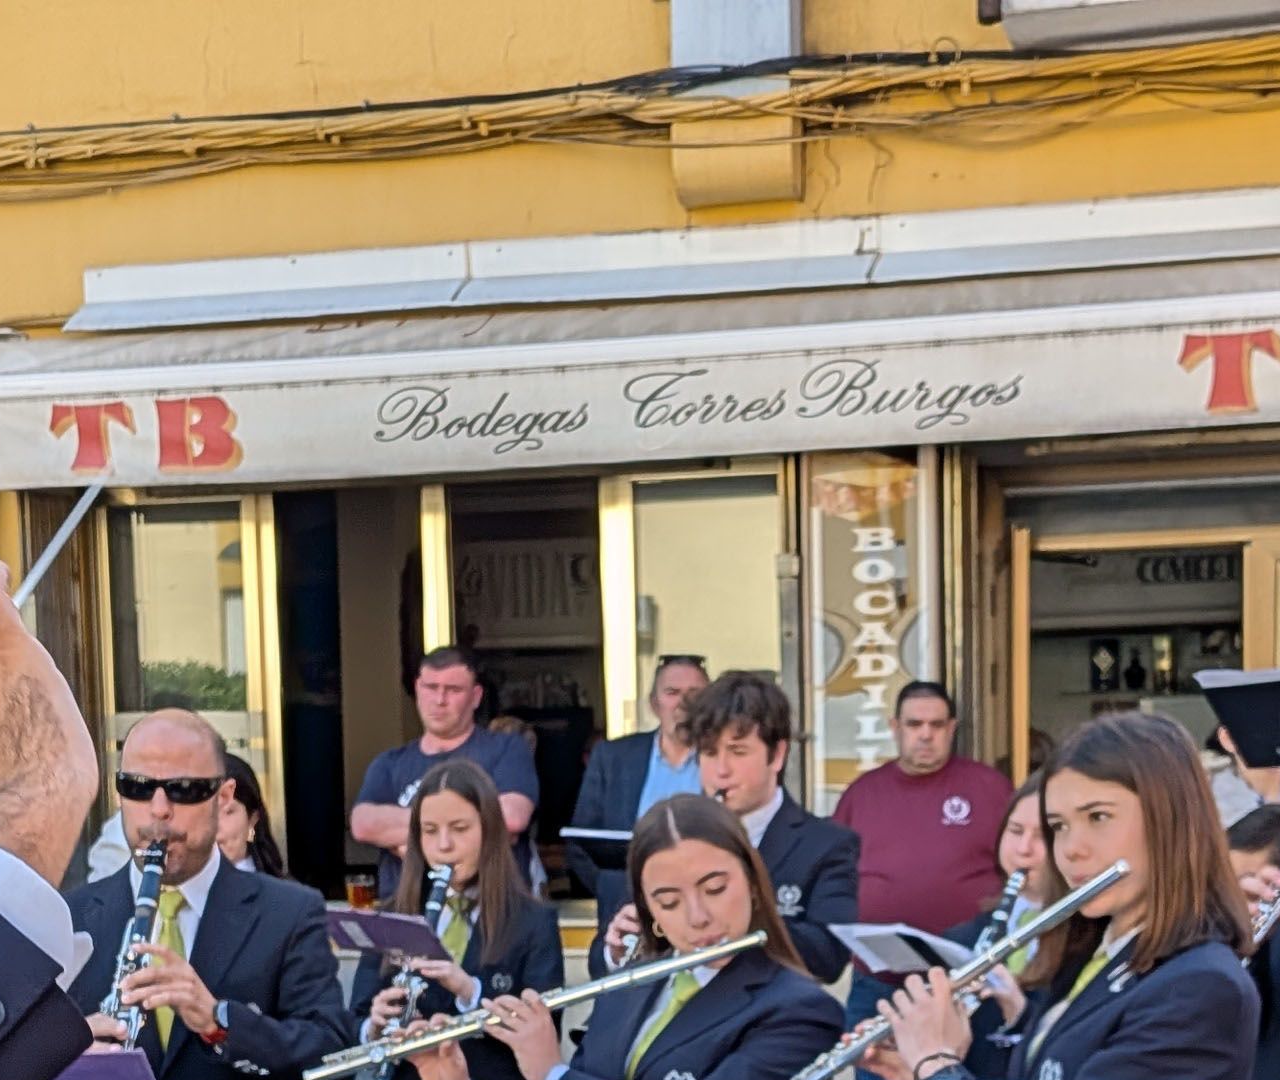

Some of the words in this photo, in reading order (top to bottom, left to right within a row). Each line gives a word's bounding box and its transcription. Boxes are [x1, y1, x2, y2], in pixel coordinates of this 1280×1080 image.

[50, 402, 135, 474] T
[156, 396, 245, 472] B
[373, 386, 590, 455] Bodegas
[623, 368, 787, 429] Torres
[794, 358, 1025, 431] Burgos
